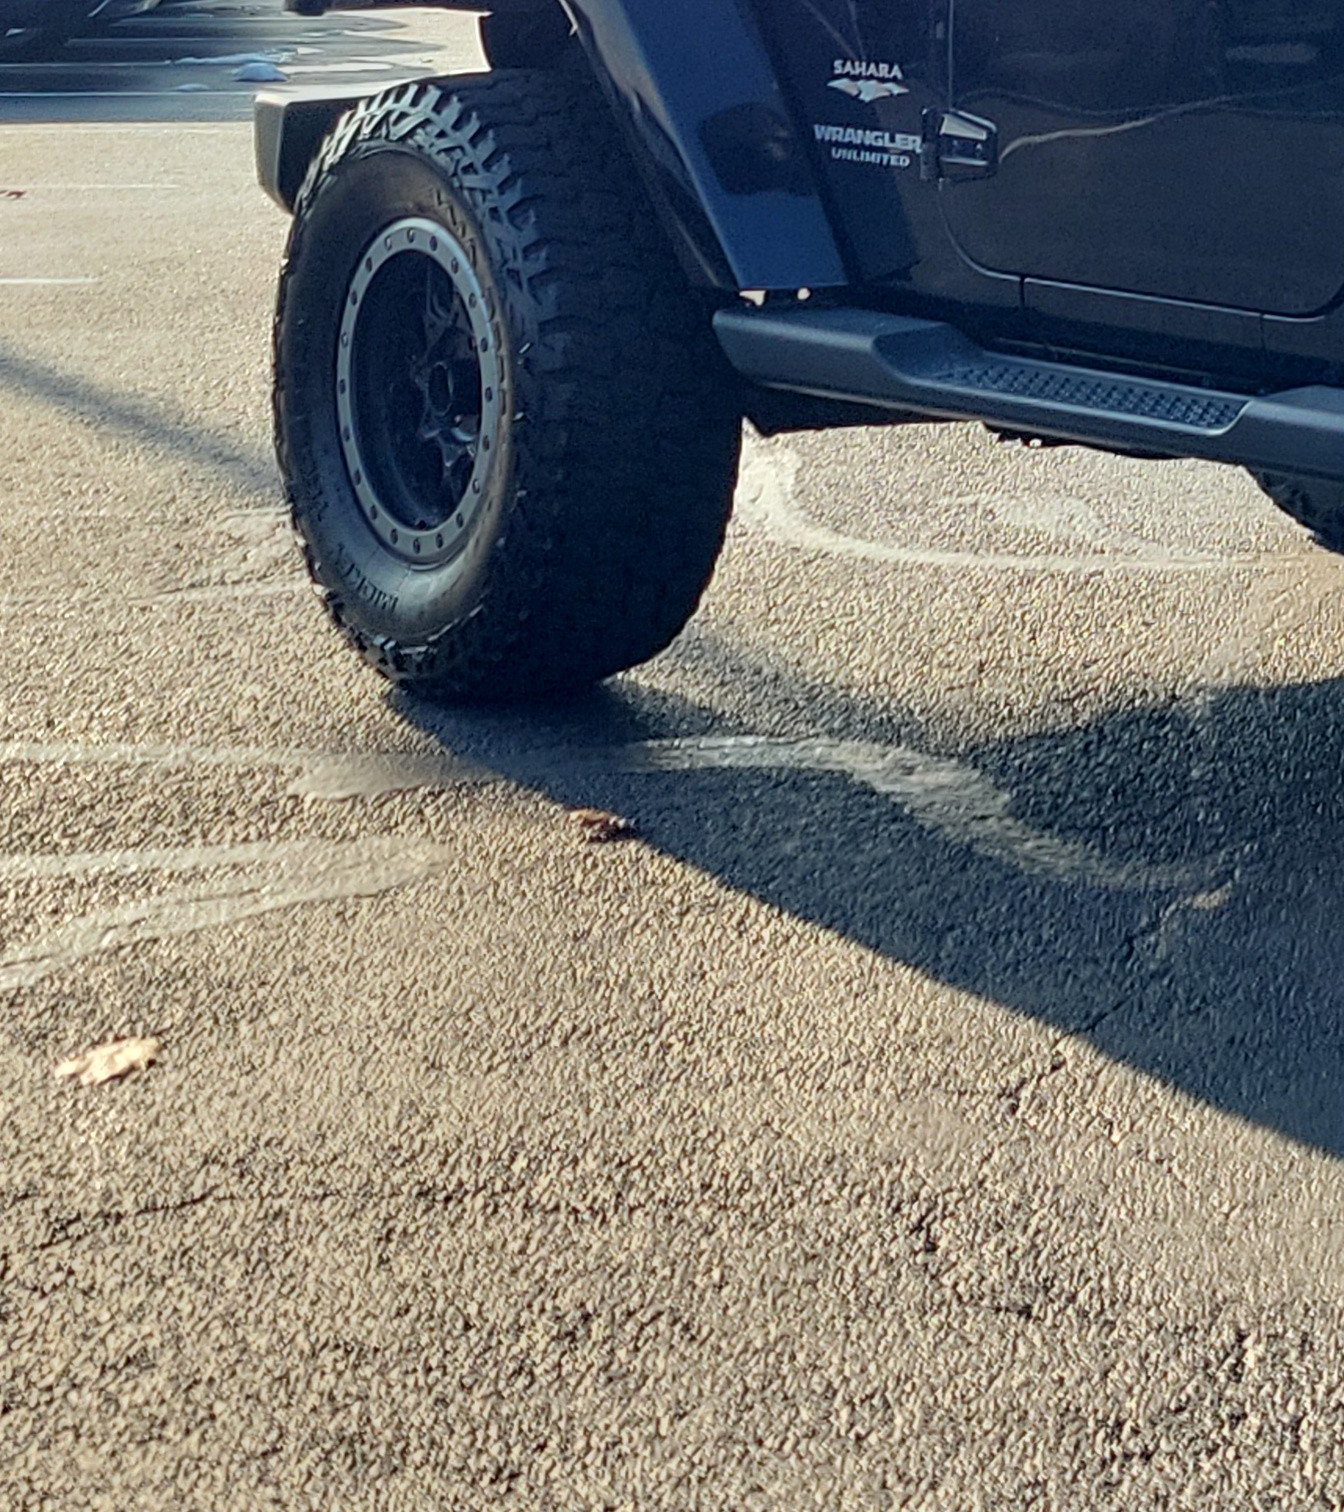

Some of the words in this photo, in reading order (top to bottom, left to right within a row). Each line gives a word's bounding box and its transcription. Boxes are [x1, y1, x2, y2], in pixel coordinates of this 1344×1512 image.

[833, 60, 903, 79] SAHARA
[814, 124, 923, 153] WRANGLER
[832, 148, 910, 167] UNLIMITED
